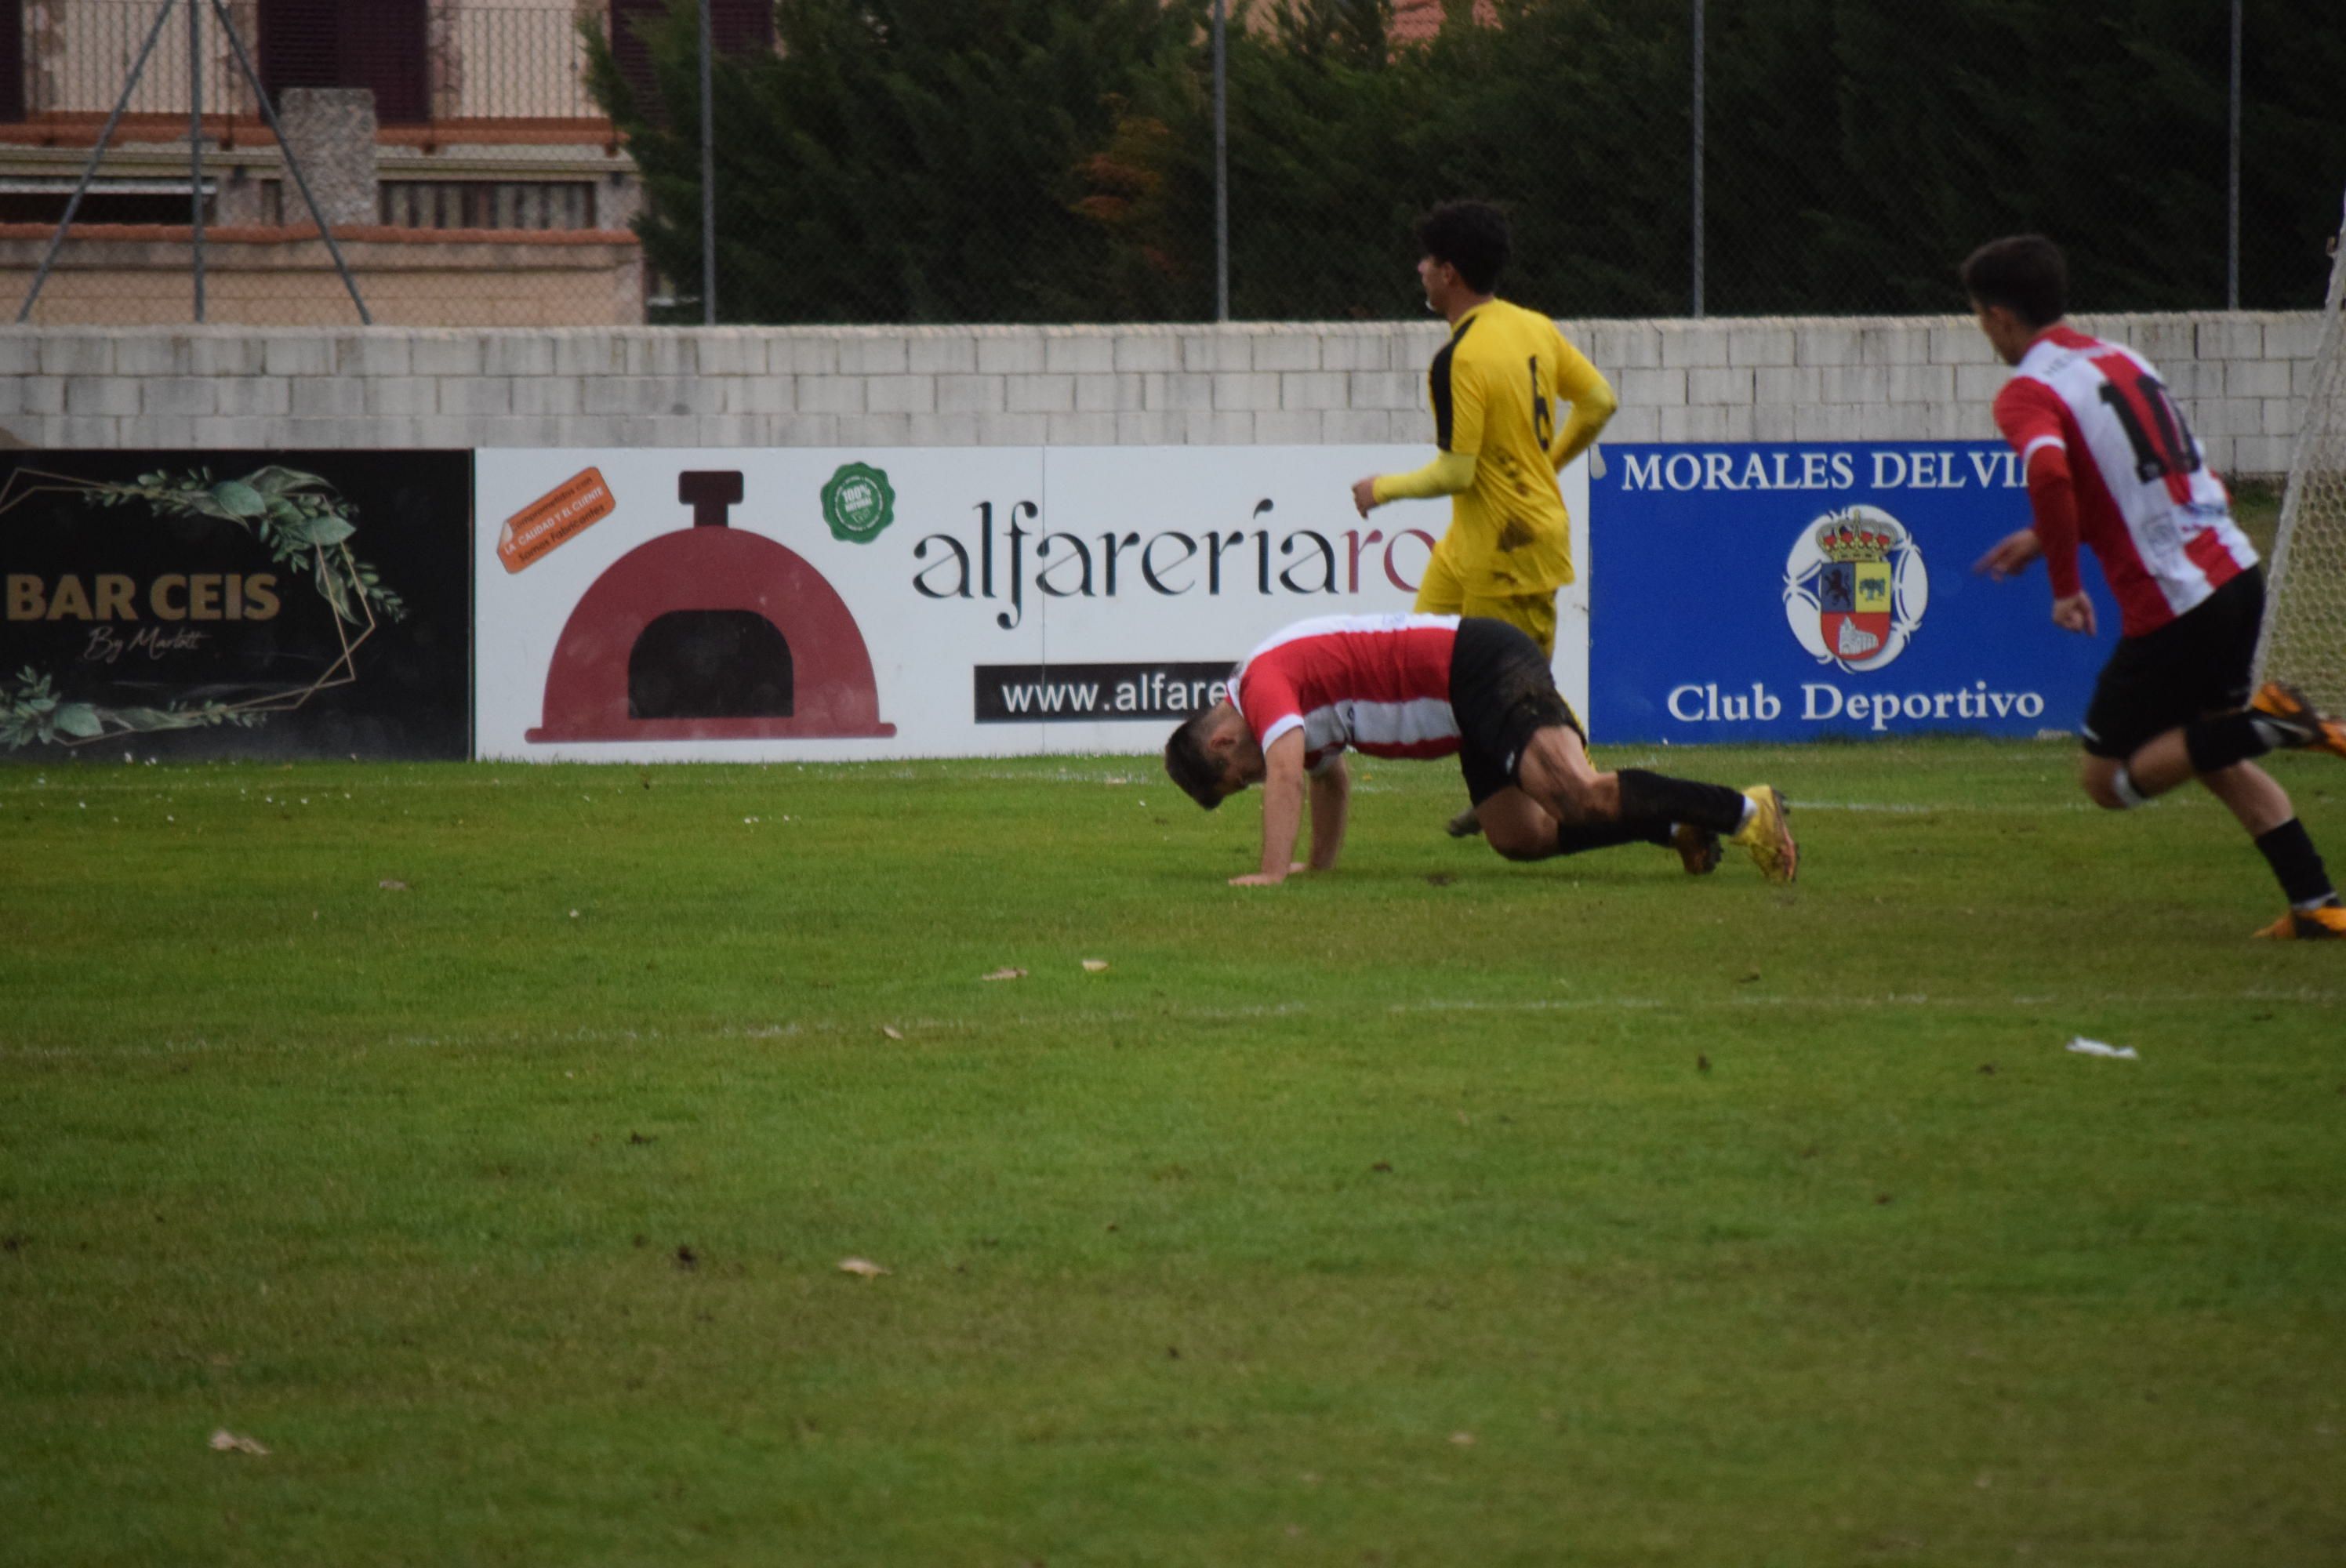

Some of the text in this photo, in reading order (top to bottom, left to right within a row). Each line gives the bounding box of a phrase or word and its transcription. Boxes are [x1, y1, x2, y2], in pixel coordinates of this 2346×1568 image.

[2097, 373, 2202, 485] 10
[842, 484, 872, 503] 100%
[1622, 451, 2029, 492] MORALES DEL VI
[518, 517, 555, 546] CALIDAD
[554, 513, 562, 523] Y
[562, 506, 573, 519] EL
[572, 486, 605, 512] CLIENTE
[5, 572, 281, 622] BAR CEIS
[82, 626, 123, 663] By
[1667, 681, 2045, 731] Club Deportivo
